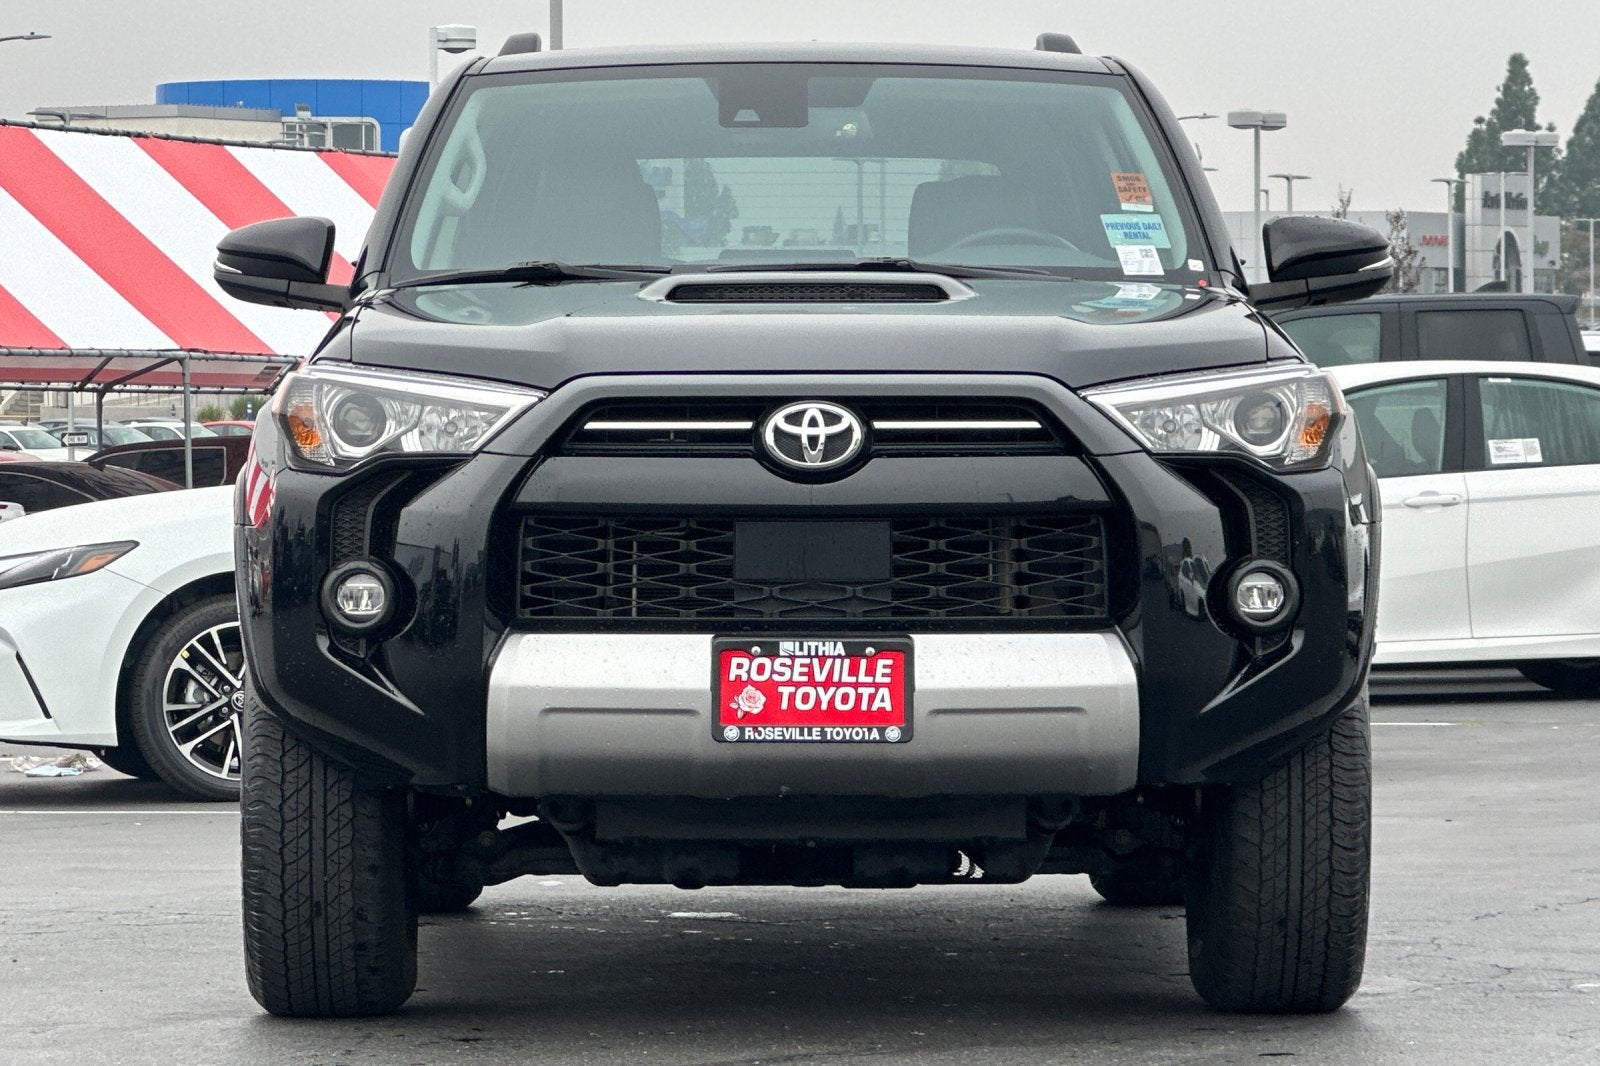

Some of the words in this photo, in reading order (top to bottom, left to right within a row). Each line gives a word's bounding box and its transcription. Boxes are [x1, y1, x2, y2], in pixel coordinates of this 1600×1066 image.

[1104, 222, 1141, 230] PREVIOUS
[1142, 222, 1162, 230] DAILY
[1123, 231, 1152, 240] RENTAL
[794, 641, 846, 656] LITHIA
[728, 657, 894, 683] ROSEVILLE
[777, 686, 893, 712] TOYOTA
[744, 727, 821, 740] ROSEVILLE
[824, 727, 880, 740] TOYOTA
